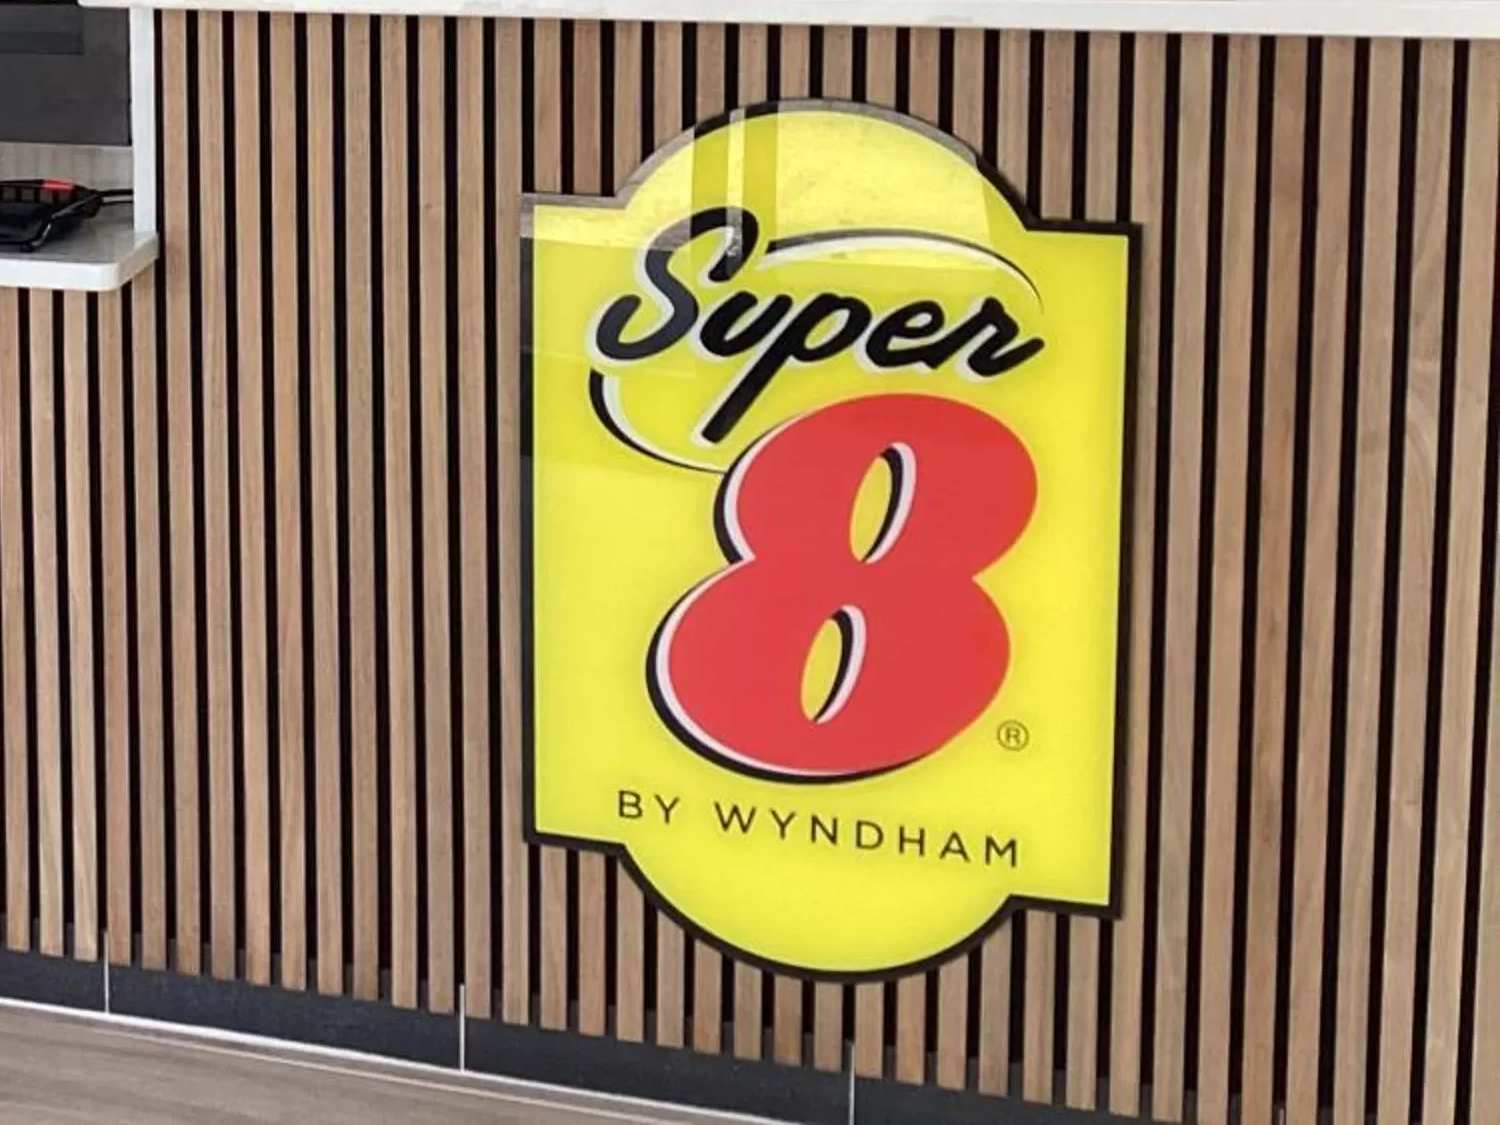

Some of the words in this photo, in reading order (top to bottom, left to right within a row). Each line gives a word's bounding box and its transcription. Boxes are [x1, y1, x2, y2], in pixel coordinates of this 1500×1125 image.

[593, 206, 1046, 445] Super
[646, 392, 1039, 786] 8
[617, 789, 680, 825] BY
[713, 800, 1018, 868] WYNDHAM
